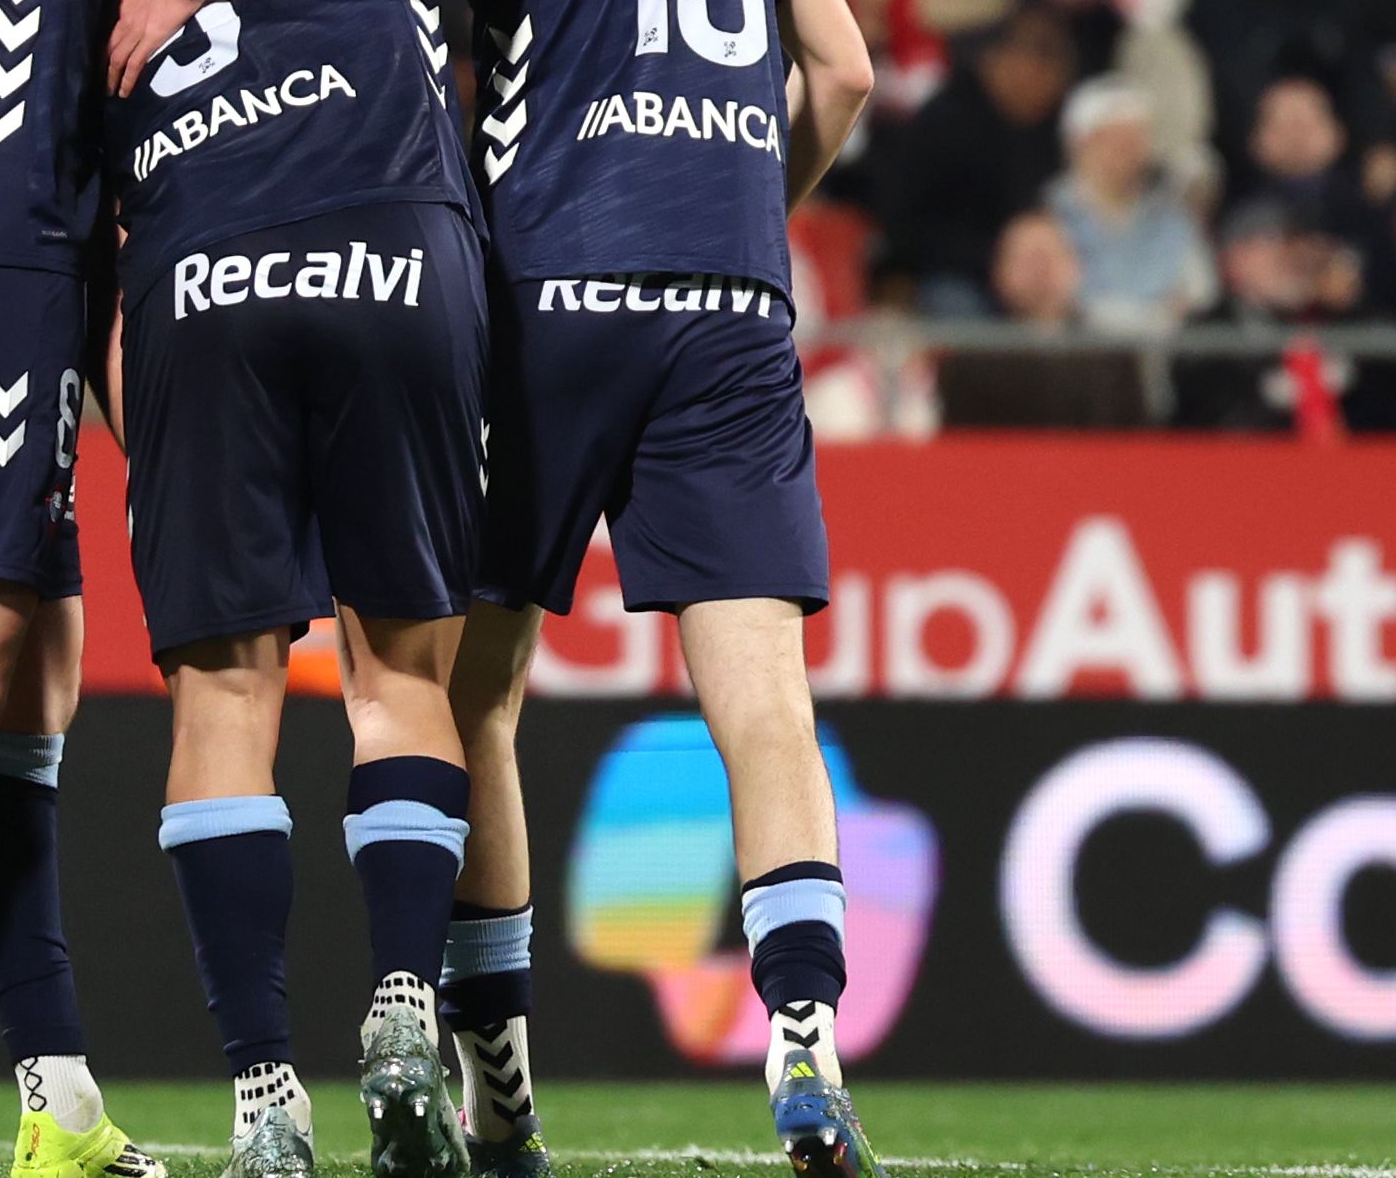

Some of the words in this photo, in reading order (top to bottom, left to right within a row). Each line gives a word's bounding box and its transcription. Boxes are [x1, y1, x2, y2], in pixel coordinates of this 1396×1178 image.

[147, 64, 357, 174] ABANCA
[596, 91, 782, 162] ABANCA
[174, 241, 424, 320] Recalvi
